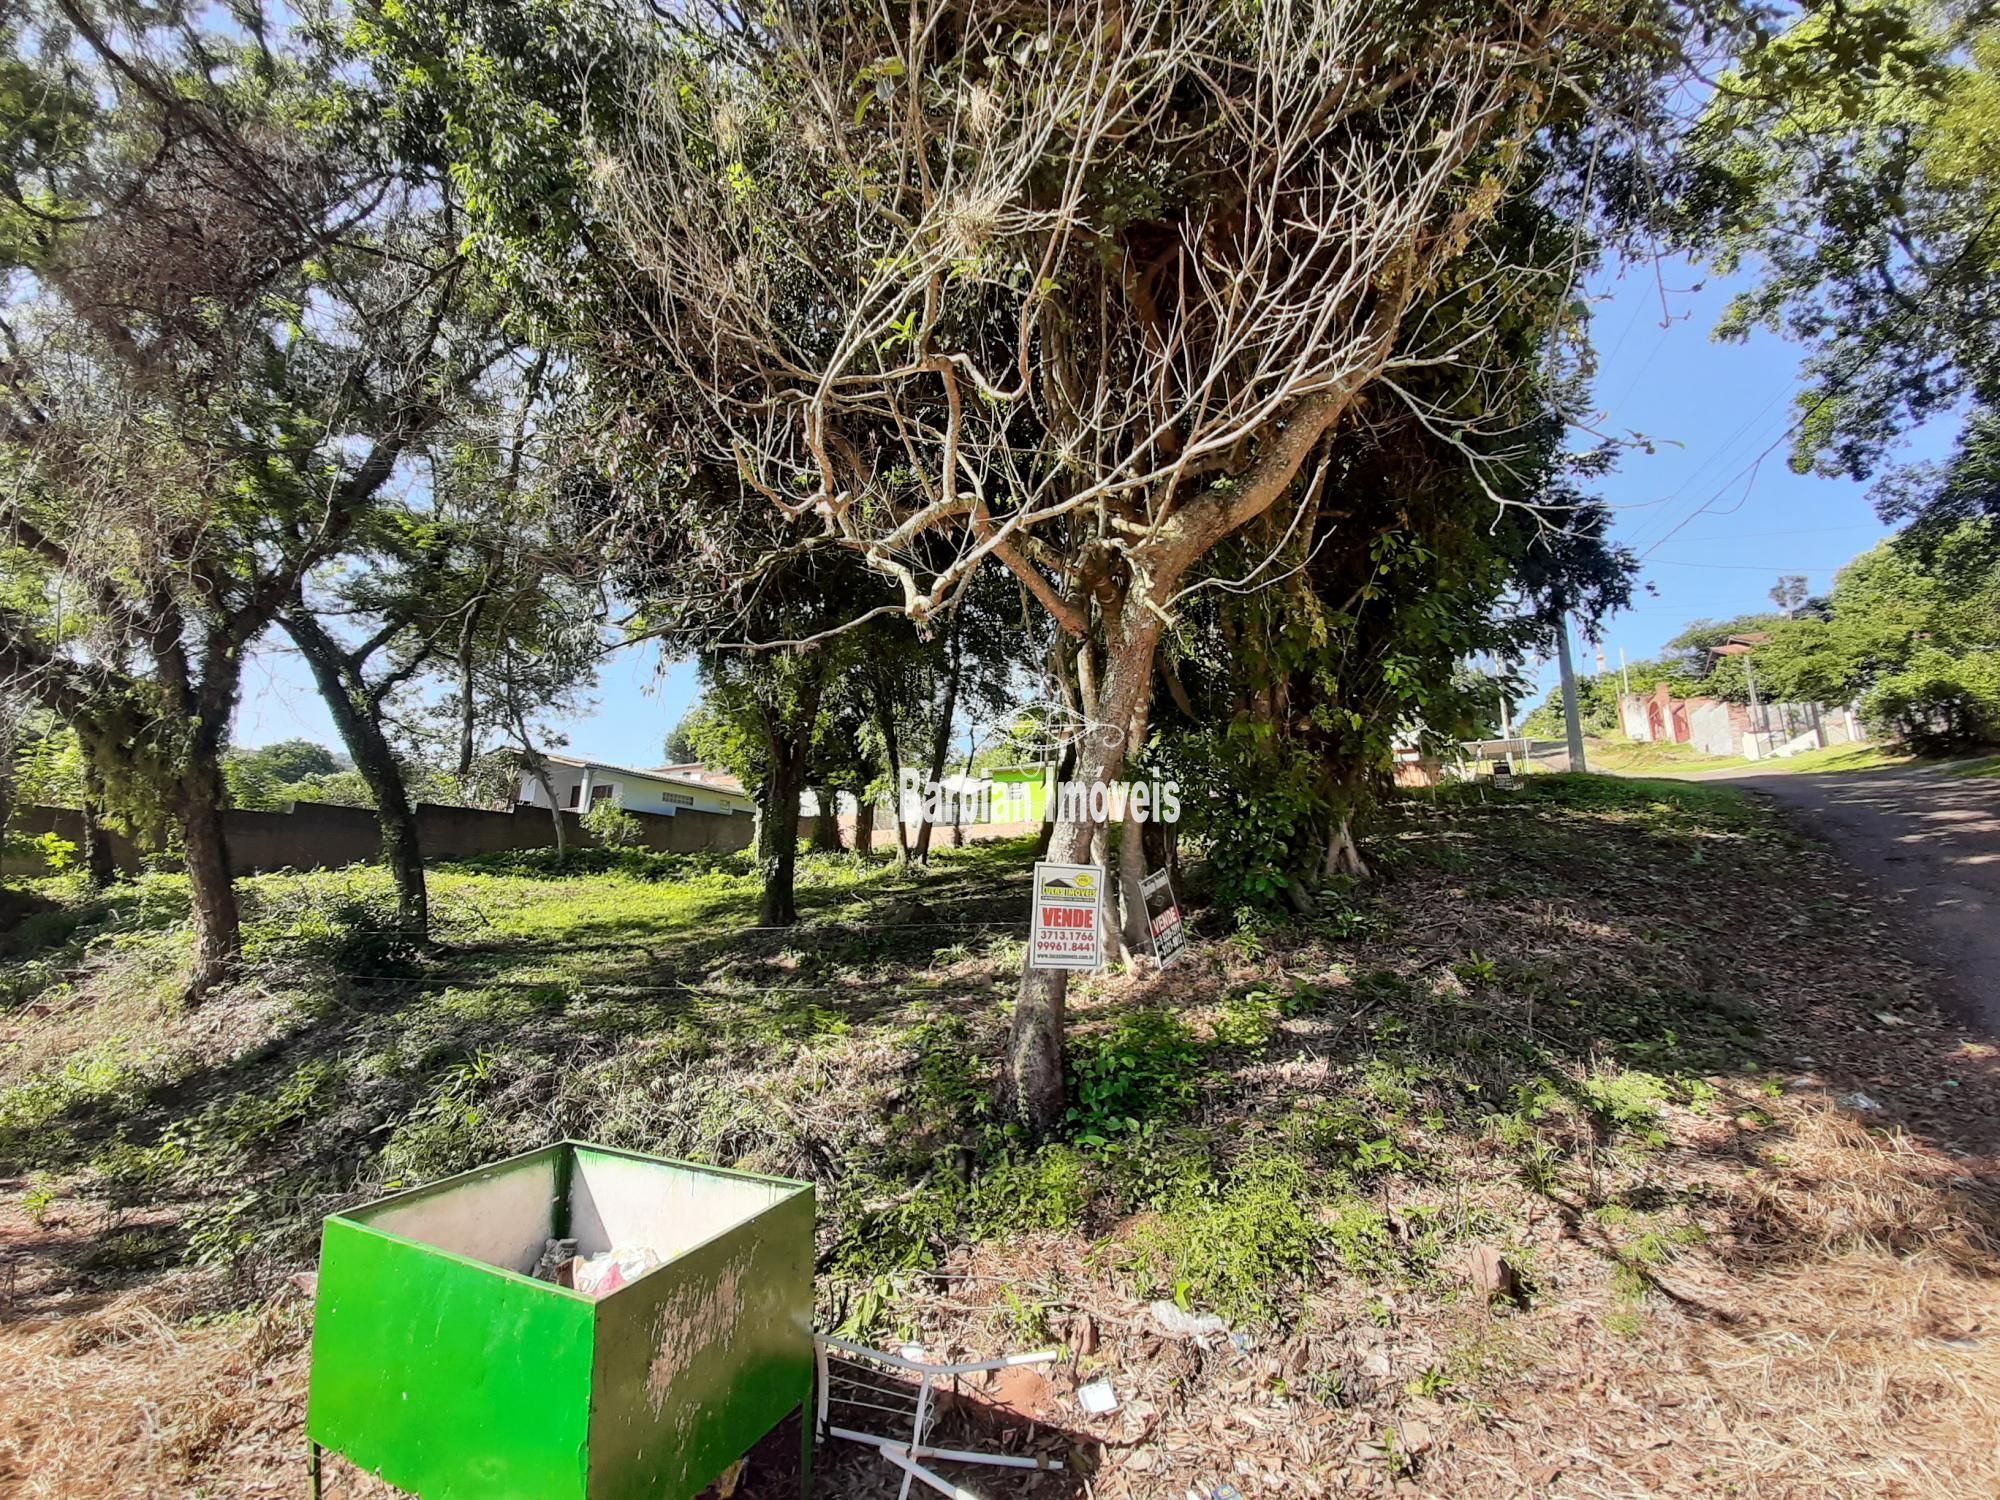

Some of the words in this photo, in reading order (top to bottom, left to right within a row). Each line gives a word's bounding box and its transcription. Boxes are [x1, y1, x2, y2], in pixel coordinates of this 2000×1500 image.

[1042, 907, 1093, 928] VENDE
[1152, 906, 1178, 933] VENDE
[1040, 931, 1094, 941] 3713.1766
[1037, 941, 1095, 952] 99961.8441
